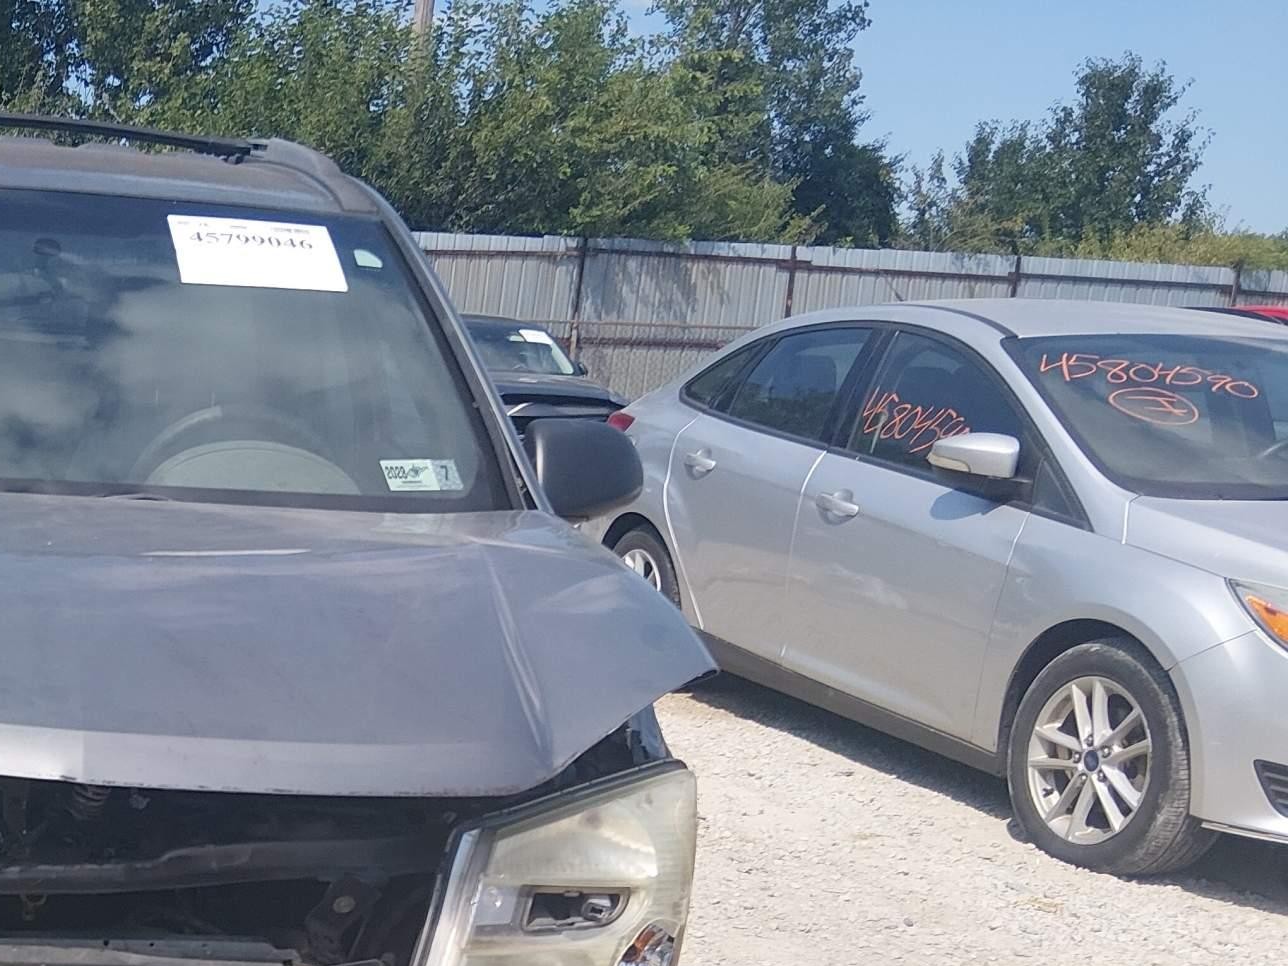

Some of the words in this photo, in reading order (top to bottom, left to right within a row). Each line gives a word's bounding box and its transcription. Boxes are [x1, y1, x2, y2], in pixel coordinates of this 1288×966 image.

[189, 231, 313, 250] 45799046
[1039, 352, 1259, 399] 45804590
[863, 384, 971, 454] 4580459
